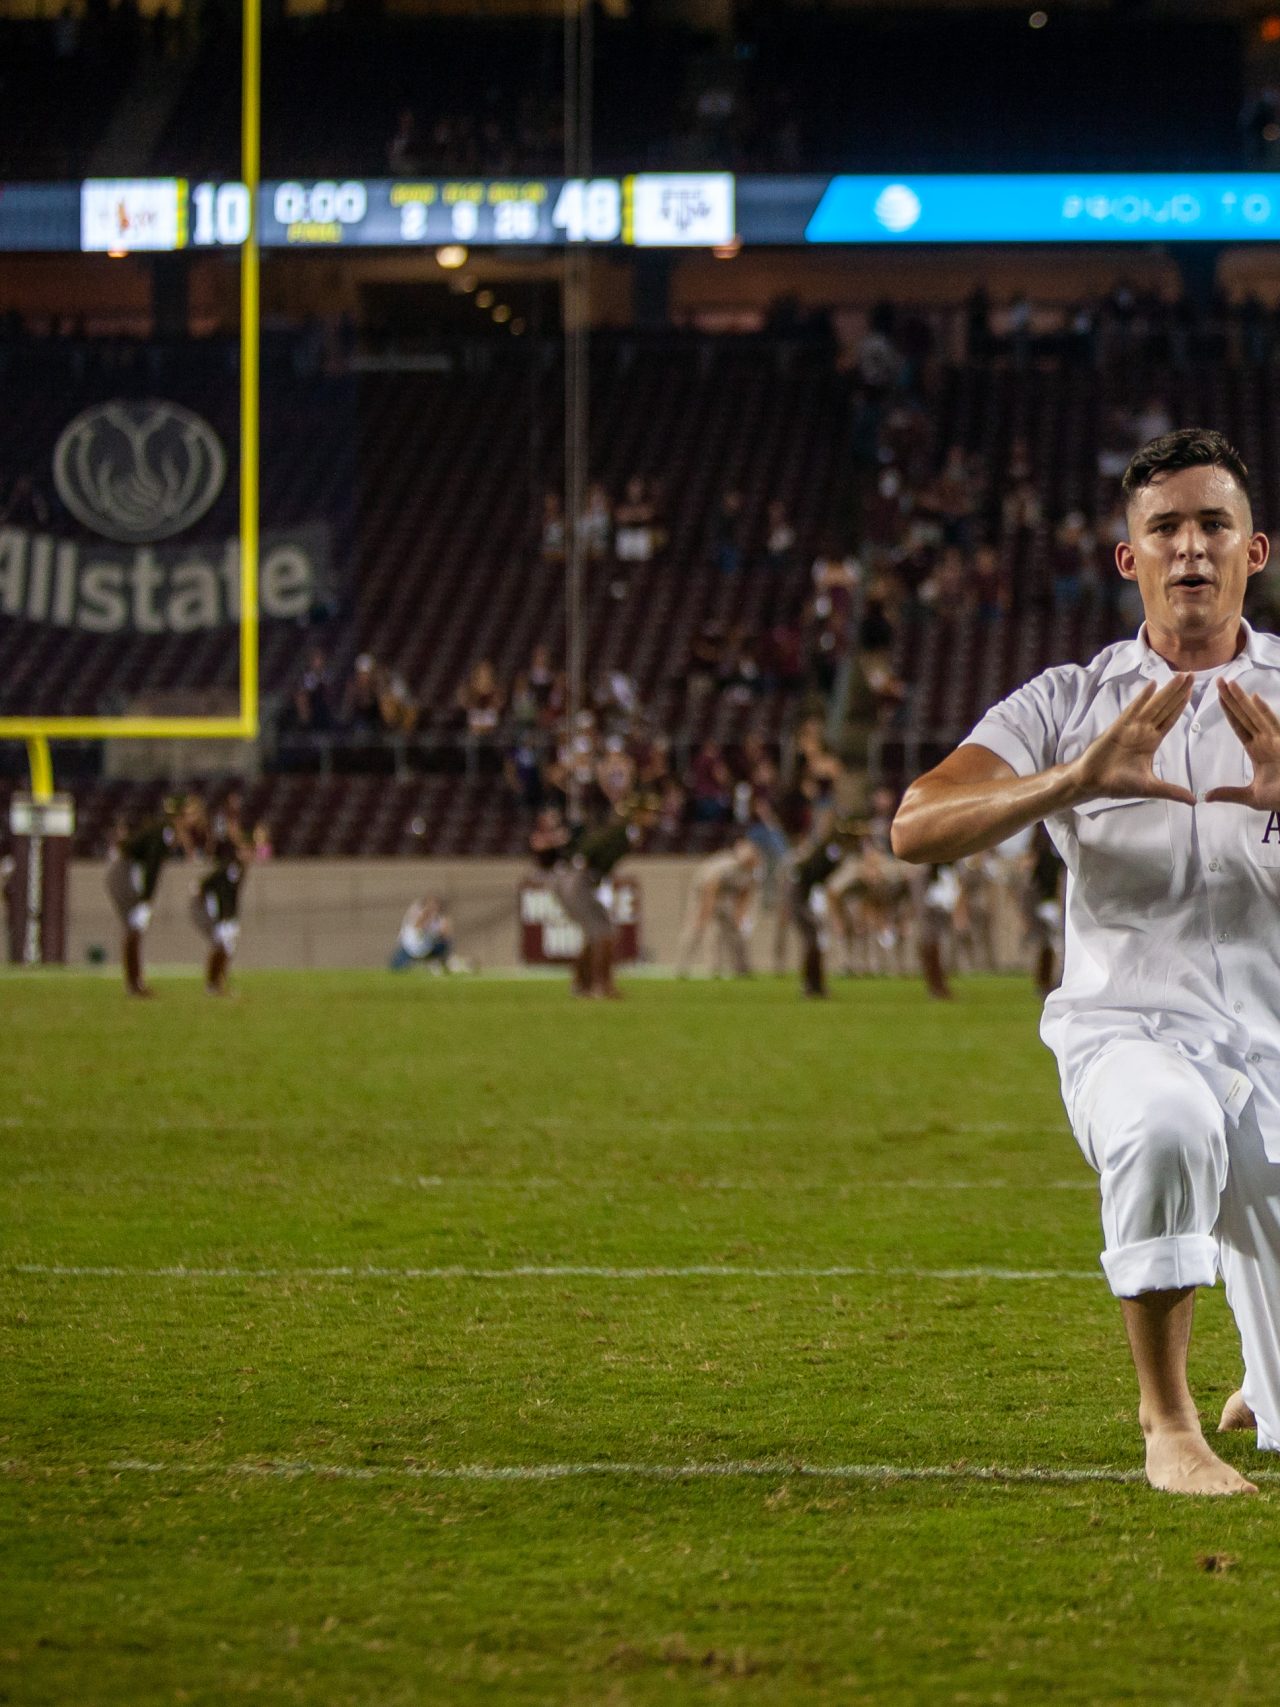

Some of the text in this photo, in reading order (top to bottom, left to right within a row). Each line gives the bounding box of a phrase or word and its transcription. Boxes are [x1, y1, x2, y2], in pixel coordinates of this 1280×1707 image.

[193, 182, 250, 245] 10
[274, 181, 367, 224] 0:00
[1062, 193, 1200, 224] PROUD
[1222, 191, 1271, 224] TO
